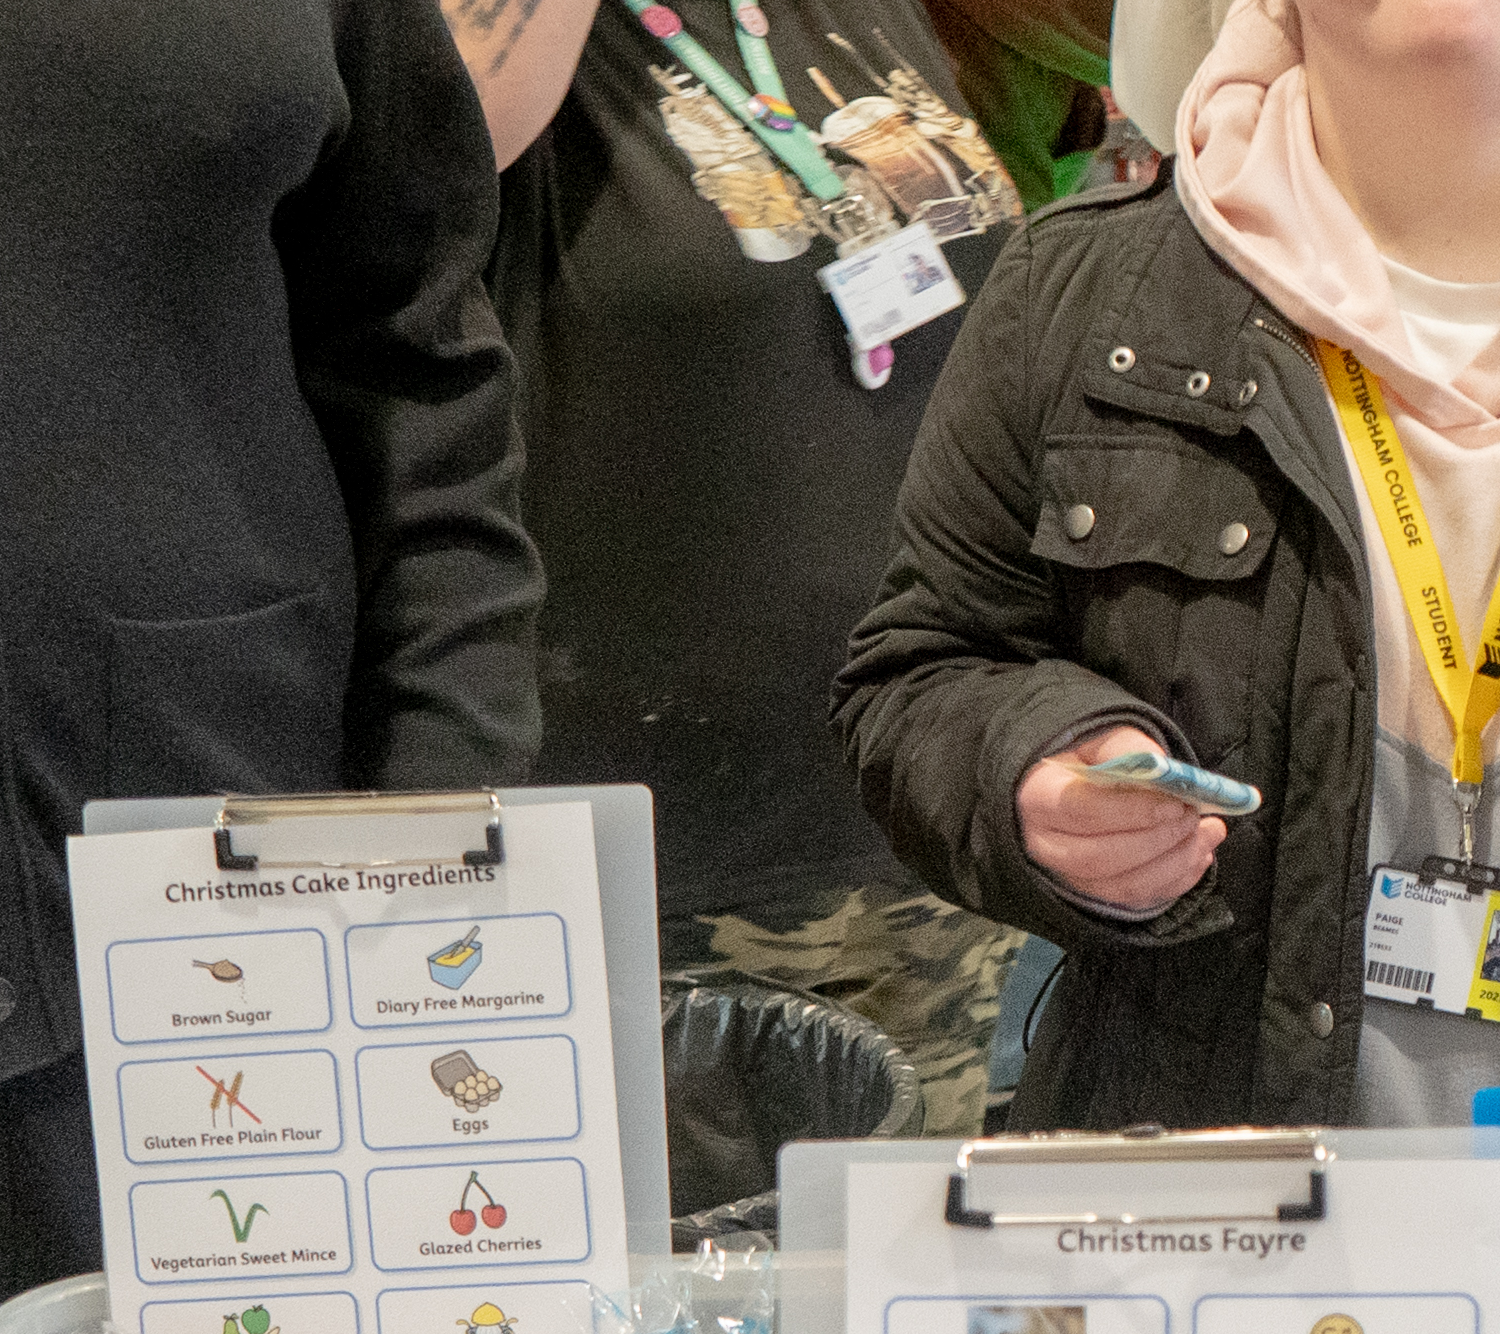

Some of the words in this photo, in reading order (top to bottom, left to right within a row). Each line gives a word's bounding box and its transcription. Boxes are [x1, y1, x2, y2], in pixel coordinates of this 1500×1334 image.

[1385, 469, 1422, 548] COLLEGE
[1421, 585, 1457, 670] STUDENT
[165, 878, 285, 904] Christmas
[292, 871, 350, 896] Cake
[356, 863, 497, 896] Ingredients
[1405, 881, 1473, 903] NOTTINGHAM
[1404, 890, 1448, 907] COLLEGE
[1375, 913, 1404, 927] PAIGE
[376, 999, 420, 1016] Diary
[424, 997, 458, 1011] Free
[462, 991, 545, 1011] Margarine
[171, 1013, 222, 1028] Brown
[225, 1009, 273, 1026] Sugar
[144, 1135, 197, 1151] Gluten
[201, 1133, 234, 1147] Free
[238, 1129, 278, 1145] Plain
[282, 1127, 323, 1142] Flour
[452, 1118, 490, 1136] Eggs
[418, 1240, 473, 1257] Glazed
[477, 1236, 542, 1254] Cherries
[1057, 1228, 1212, 1254] Christmas
[1222, 1229, 1307, 1259] Fayre
[151, 1253, 237, 1272] Vegetarian
[240, 1250, 288, 1267] Sweet
[291, 1247, 337, 1263] Mince
